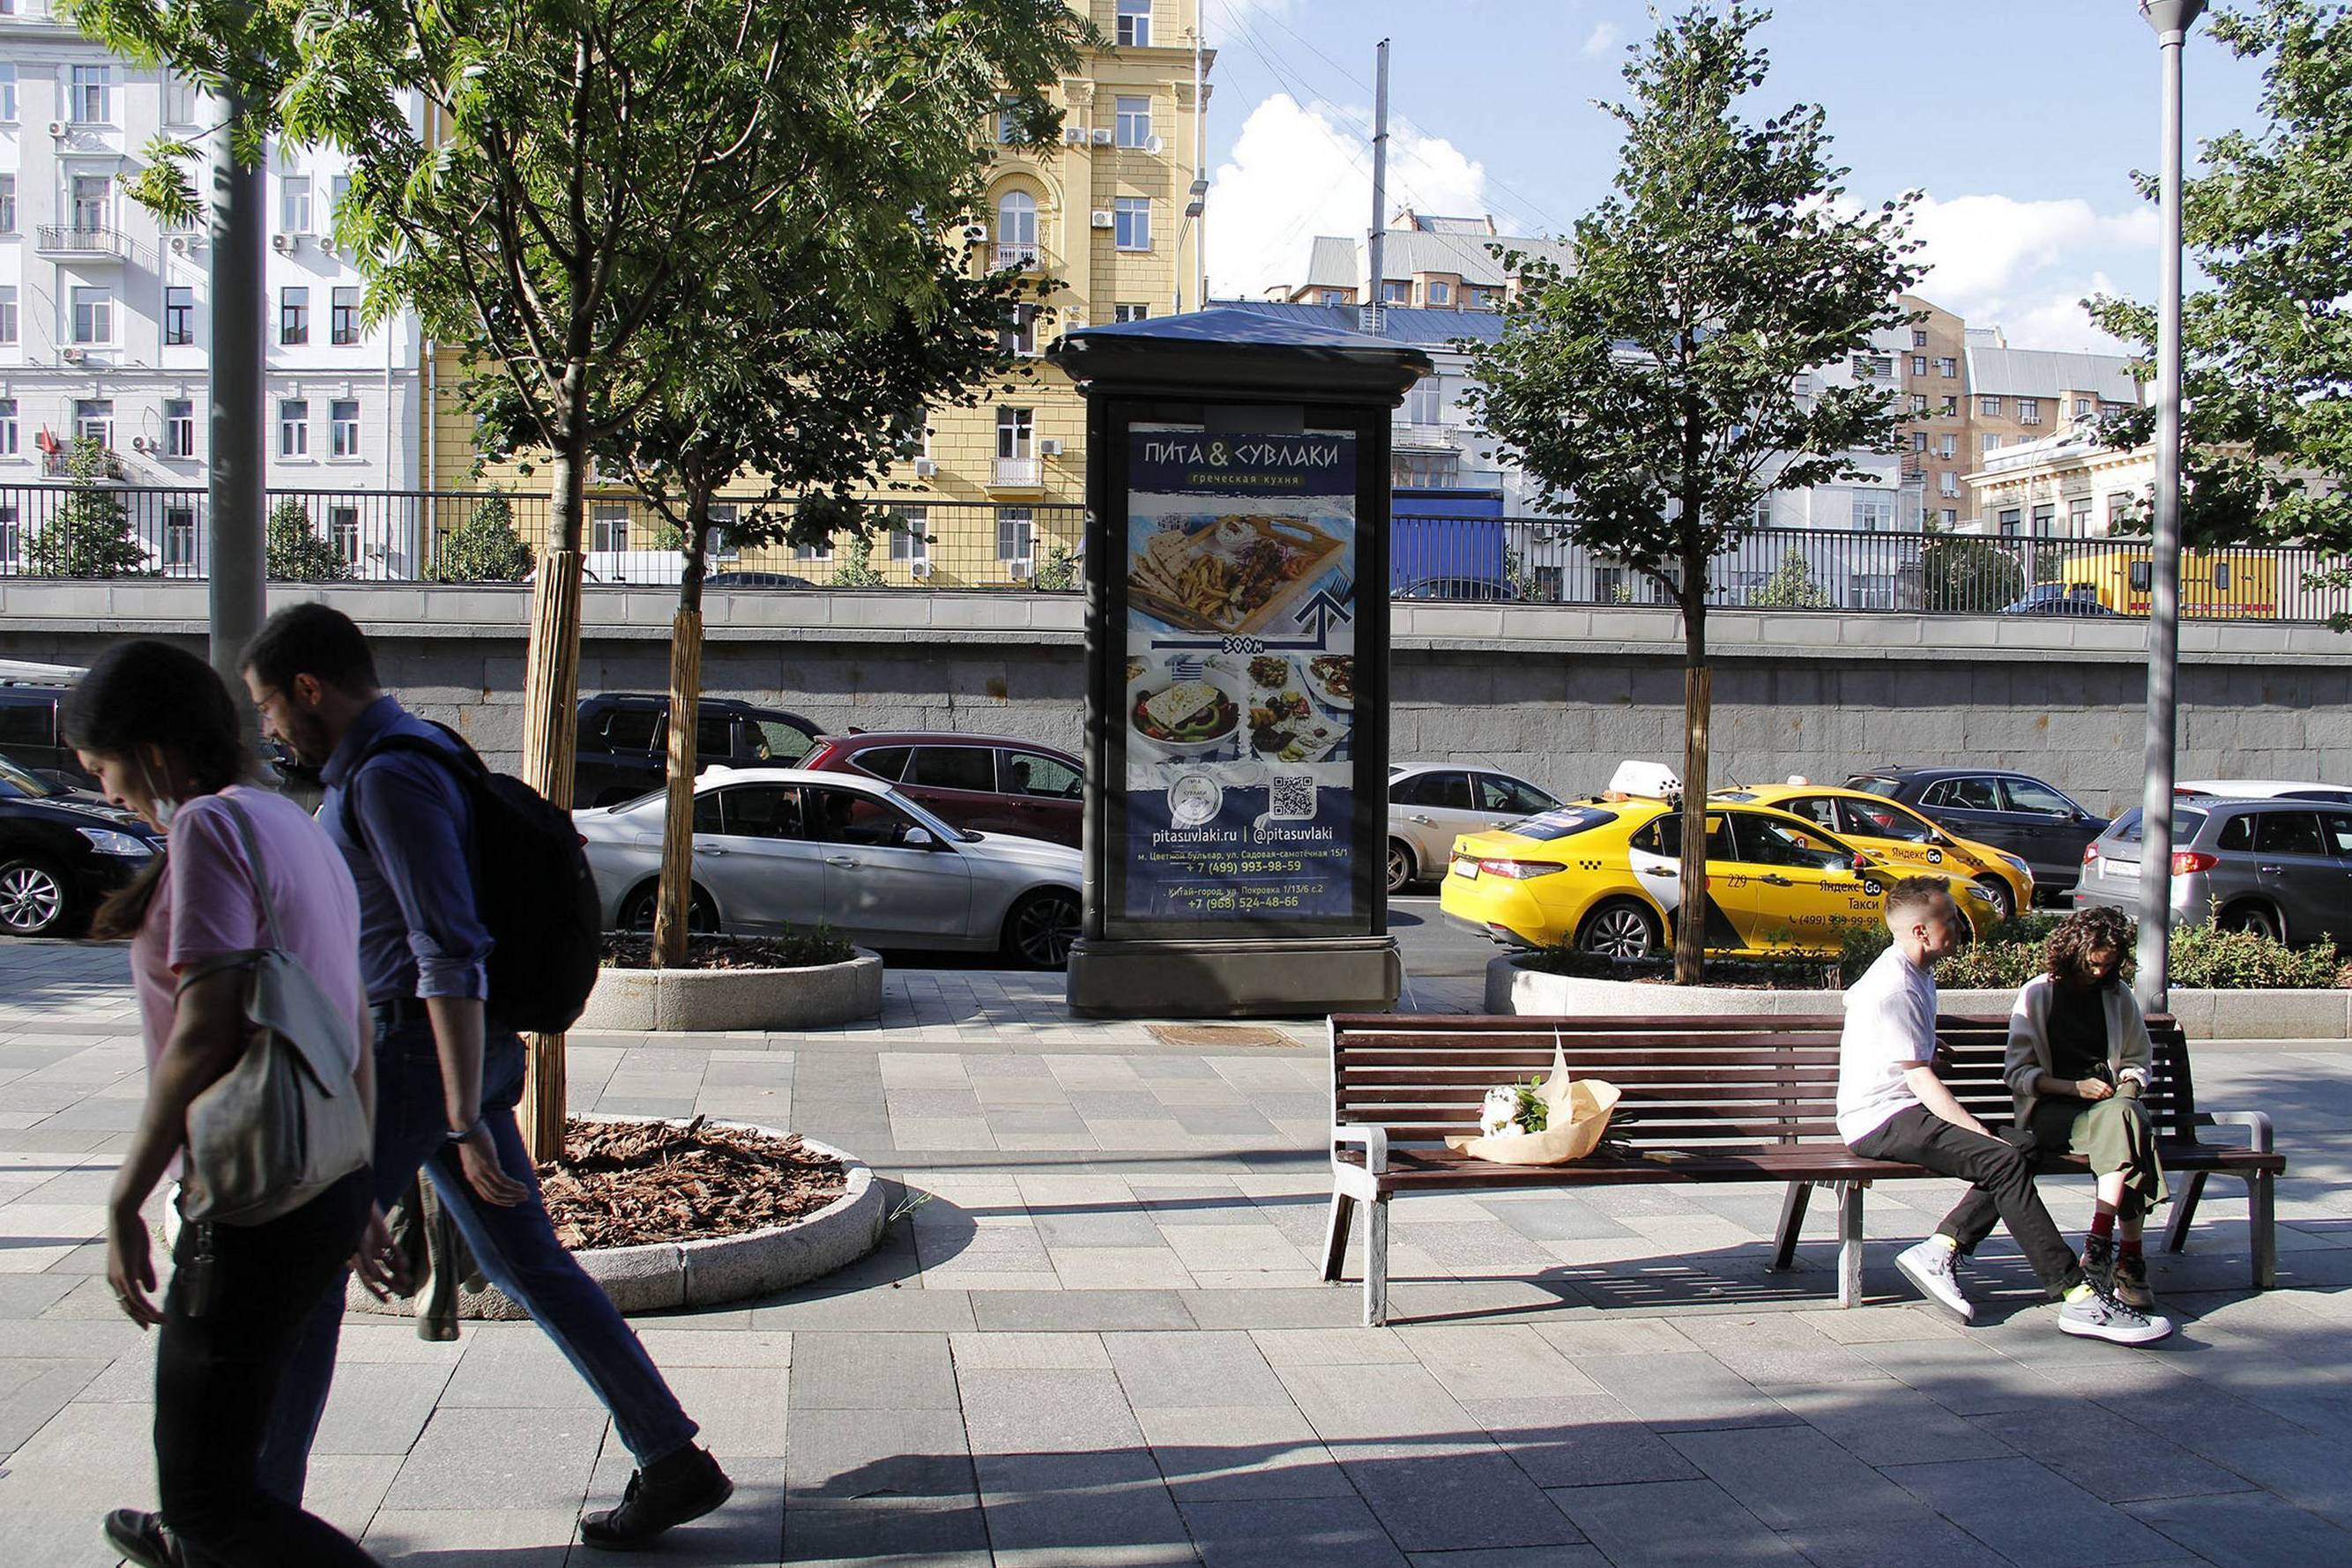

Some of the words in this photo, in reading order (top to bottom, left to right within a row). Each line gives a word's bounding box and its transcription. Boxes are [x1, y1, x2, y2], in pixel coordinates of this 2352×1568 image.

[1145, 441, 1204, 464] ПИТА
[1209, 442, 1229, 465] &
[1234, 443, 1338, 468] СУВЛАКИ
[1192, 474, 1257, 484] греческая
[1263, 475, 1299, 485] кухня
[1152, 828, 1238, 846] pitasuvlaki.ru
[1253, 826, 1333, 844] @pitasuvlaki
[1330, 848, 1348, 858] 15/1
[1892, 847, 1924, 859] Яндекс
[1927, 851, 1941, 863] Go
[1197, 863, 1204, 873] 7
[1209, 862, 1238, 875] (499)
[1241, 861, 1301, 873] 993-98-59
[1728, 873, 1747, 888] 229
[1820, 880, 1860, 892] Яндекс
[1865, 881, 1880, 894] Go
[1241, 886, 1280, 895] Покровка
[1188, 900, 1202, 909] +7
[1207, 899, 1235, 910] (968)
[1239, 896, 1299, 908] 524-48-66
[1848, 897, 1879, 910] Такси
[1799, 915, 1826, 925] (499)
